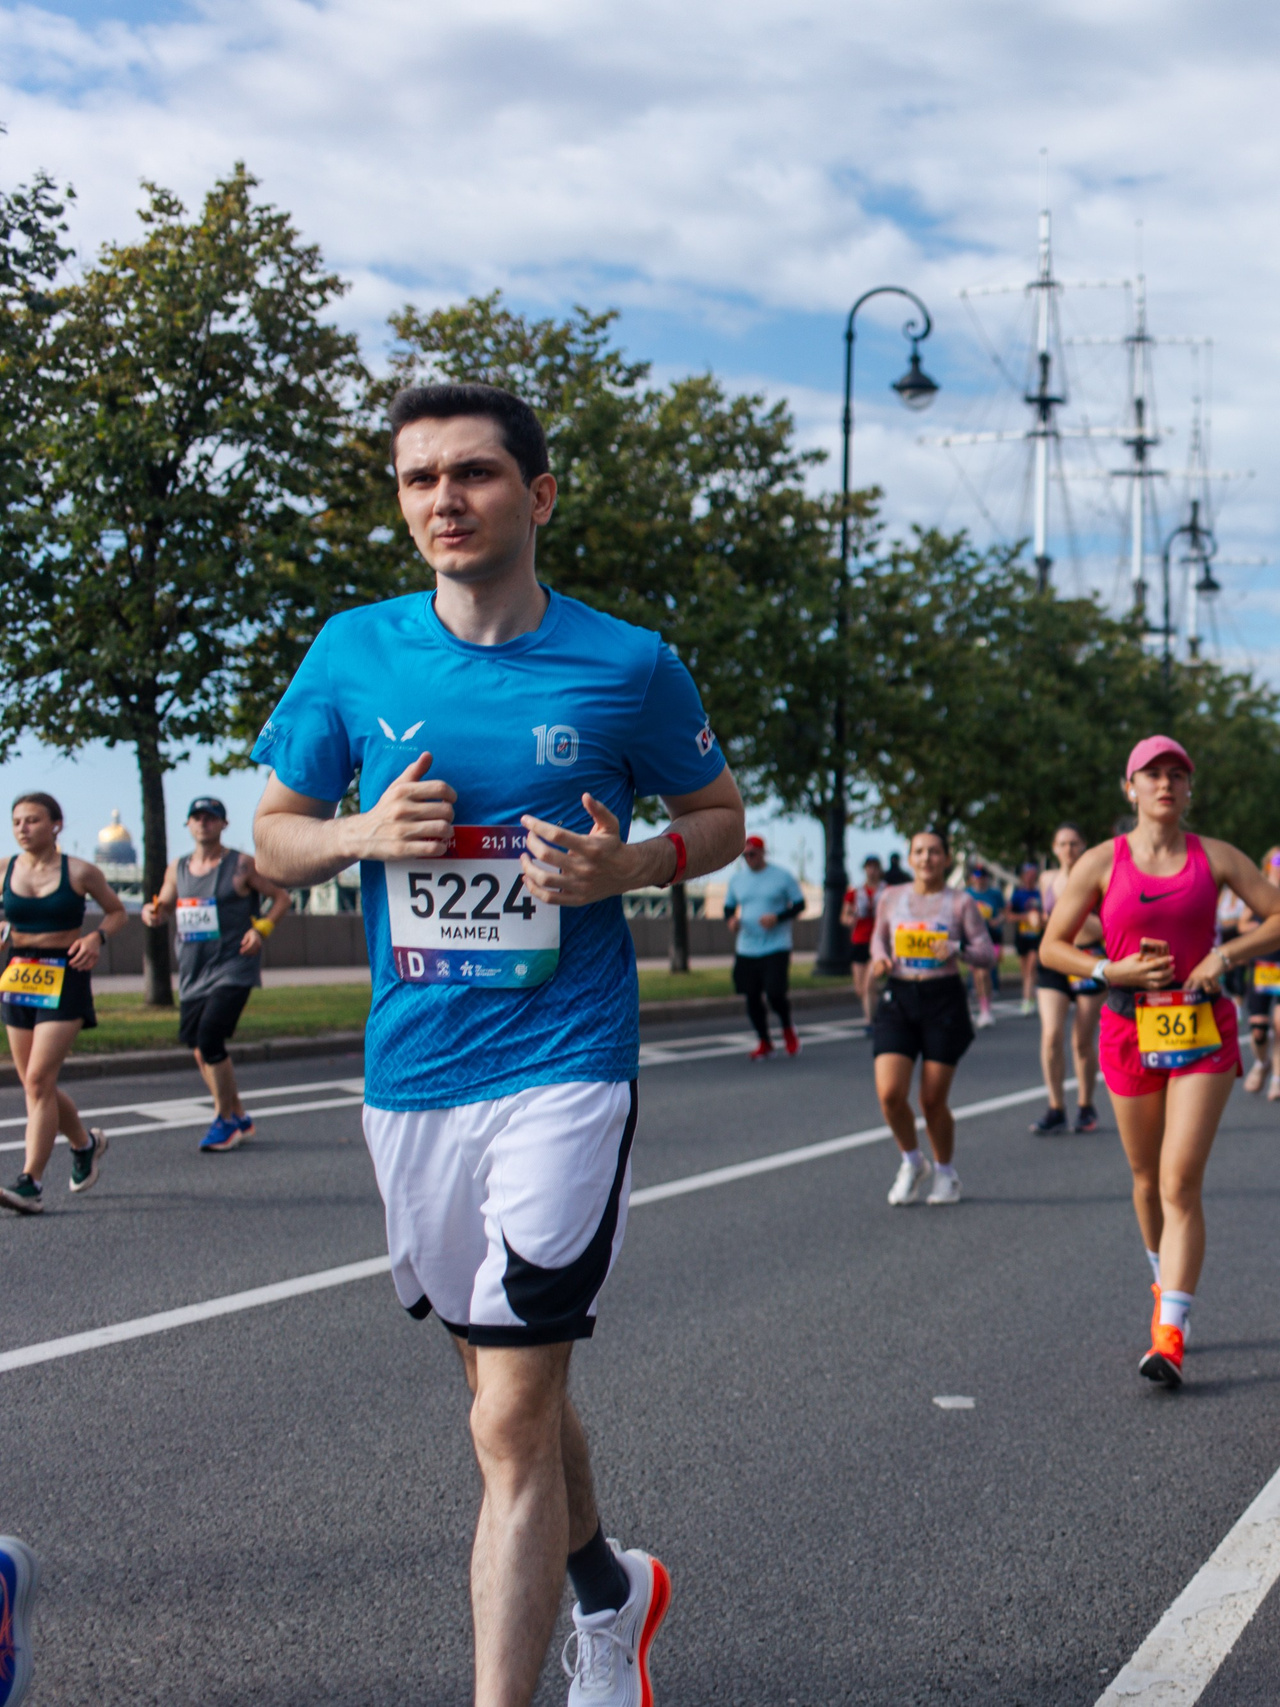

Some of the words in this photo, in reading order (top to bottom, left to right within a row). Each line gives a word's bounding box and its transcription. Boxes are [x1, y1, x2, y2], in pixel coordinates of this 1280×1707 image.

[532, 724, 579, 766] 10
[482, 835, 507, 851] 21,1
[408, 872, 536, 920] 5224
[440, 926, 500, 942] МАМЕД
[407, 951, 425, 977] D
[9, 967, 55, 986] 3665
[1157, 1012, 1198, 1036] 361
[1147, 1051, 1159, 1068] C
